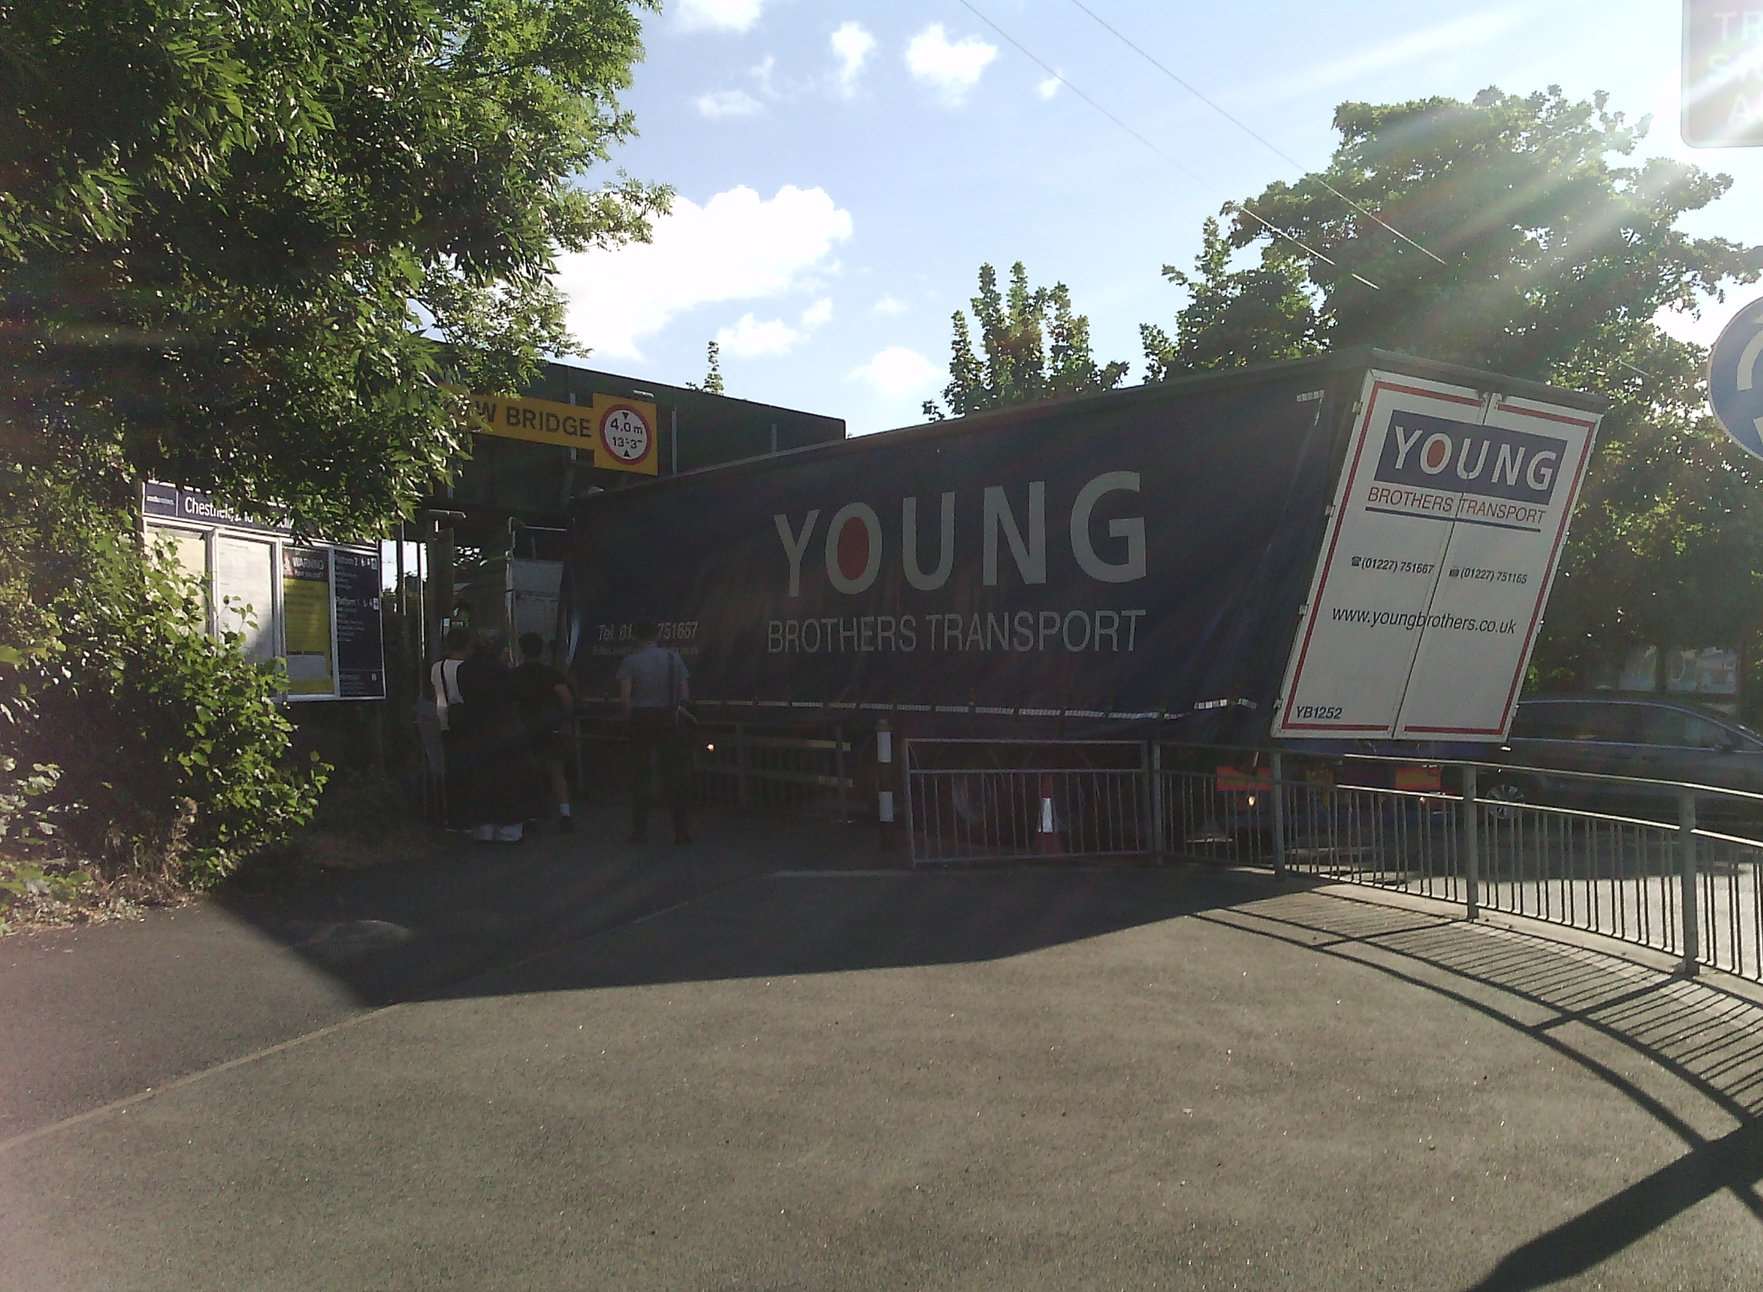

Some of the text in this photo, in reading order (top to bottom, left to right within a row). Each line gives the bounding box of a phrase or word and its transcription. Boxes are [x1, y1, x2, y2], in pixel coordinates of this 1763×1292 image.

[506, 406, 593, 438] BRIDGE
[1394, 425, 1557, 491] YOUNG
[1367, 486, 1547, 525] BROTHERS TRANSPORT
[773, 470, 1147, 598] YOUNG
[1361, 557, 1399, 574] (01227)
[1460, 567, 1495, 583] (01227)
[767, 609, 1147, 654] BROTHERS TRANSPORT
[1332, 607, 1517, 635] www.youngbrothers.co.uk
[1296, 705, 1343, 720] YB1252
